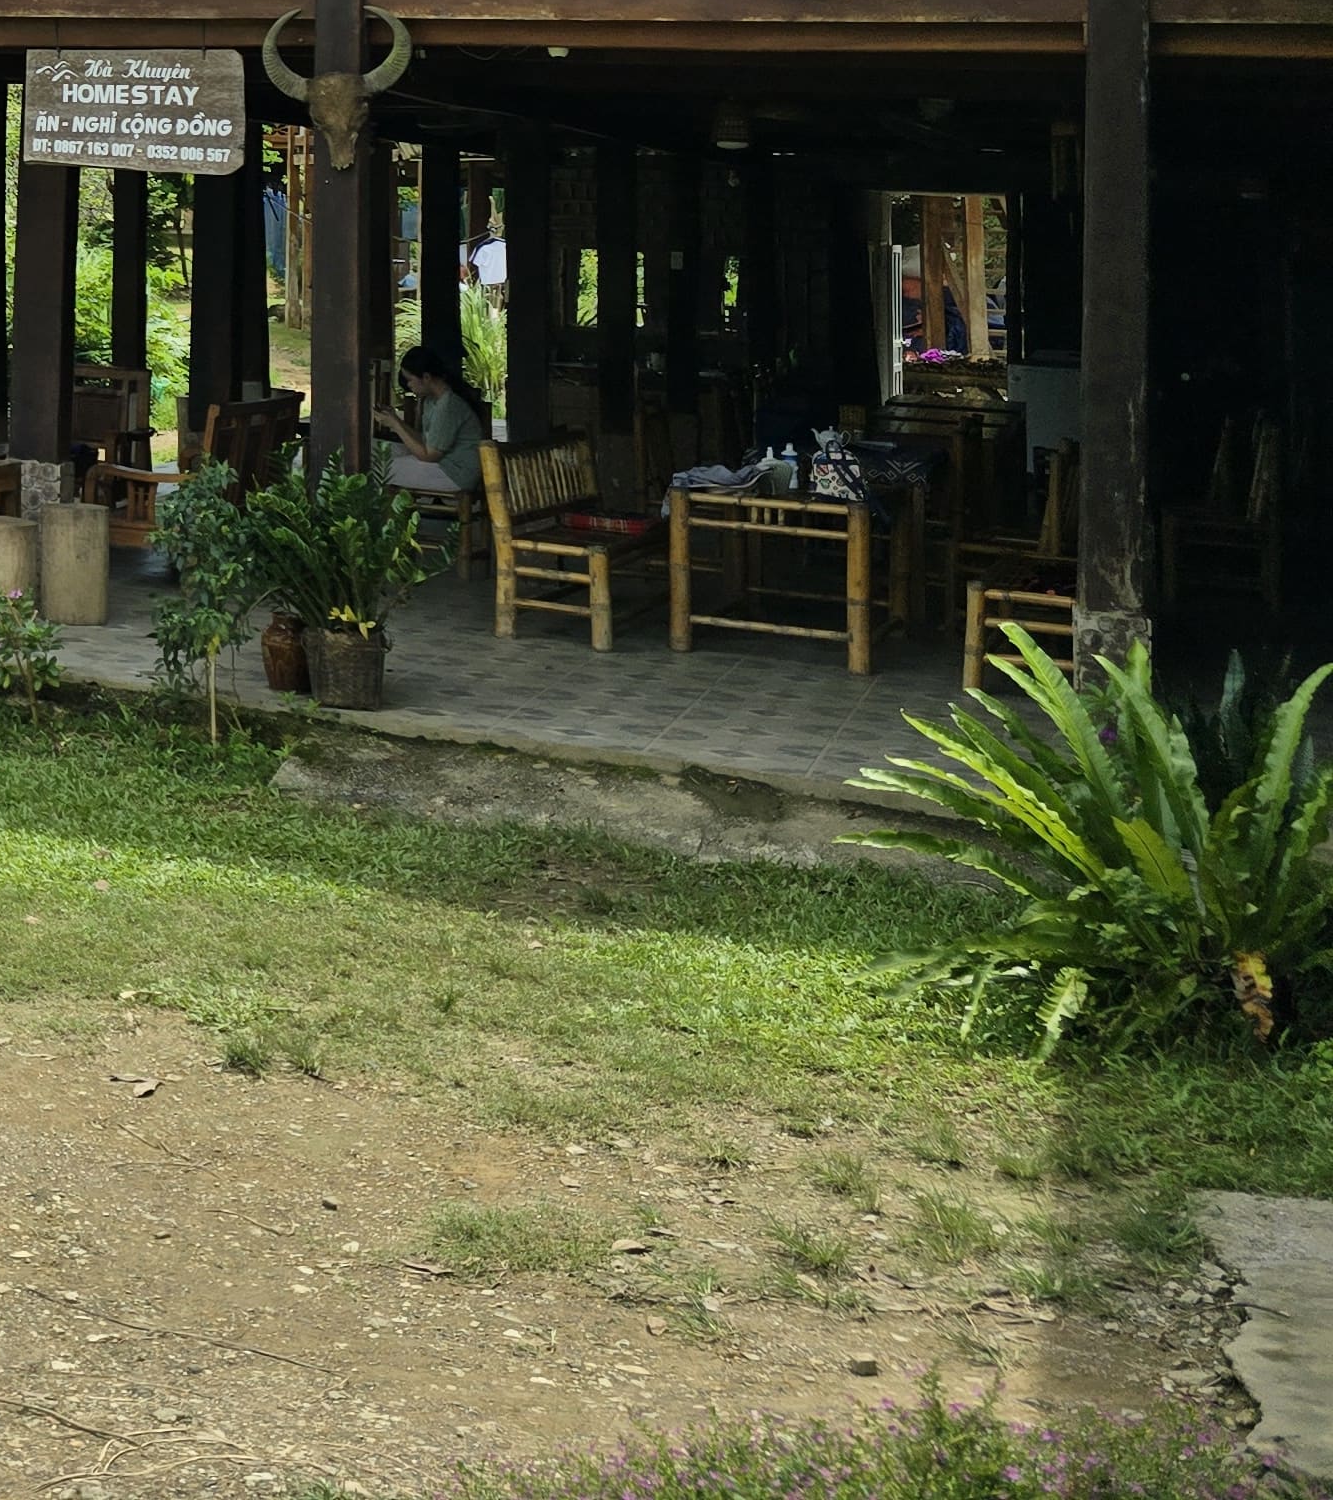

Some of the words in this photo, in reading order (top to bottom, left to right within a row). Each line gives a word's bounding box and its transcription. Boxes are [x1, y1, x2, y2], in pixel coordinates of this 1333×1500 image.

[85, 58, 113, 77] Hà
[121, 59, 191, 82] Khuyên
[63, 83, 199, 106] HOMESTAY
[36, 111, 59, 132] ĂN
[71, 111, 118, 134] NGHỈ
[121, 113, 172, 139] CỘNG
[176, 112, 232, 136] ĐỒNG
[54, 141, 83, 154] 0867
[87, 142, 108, 156] 163
[112, 144, 134, 157] 007
[147, 145, 177, 159] 0352
[181, 147, 204, 161] 006
[207, 148, 231, 162] 567
